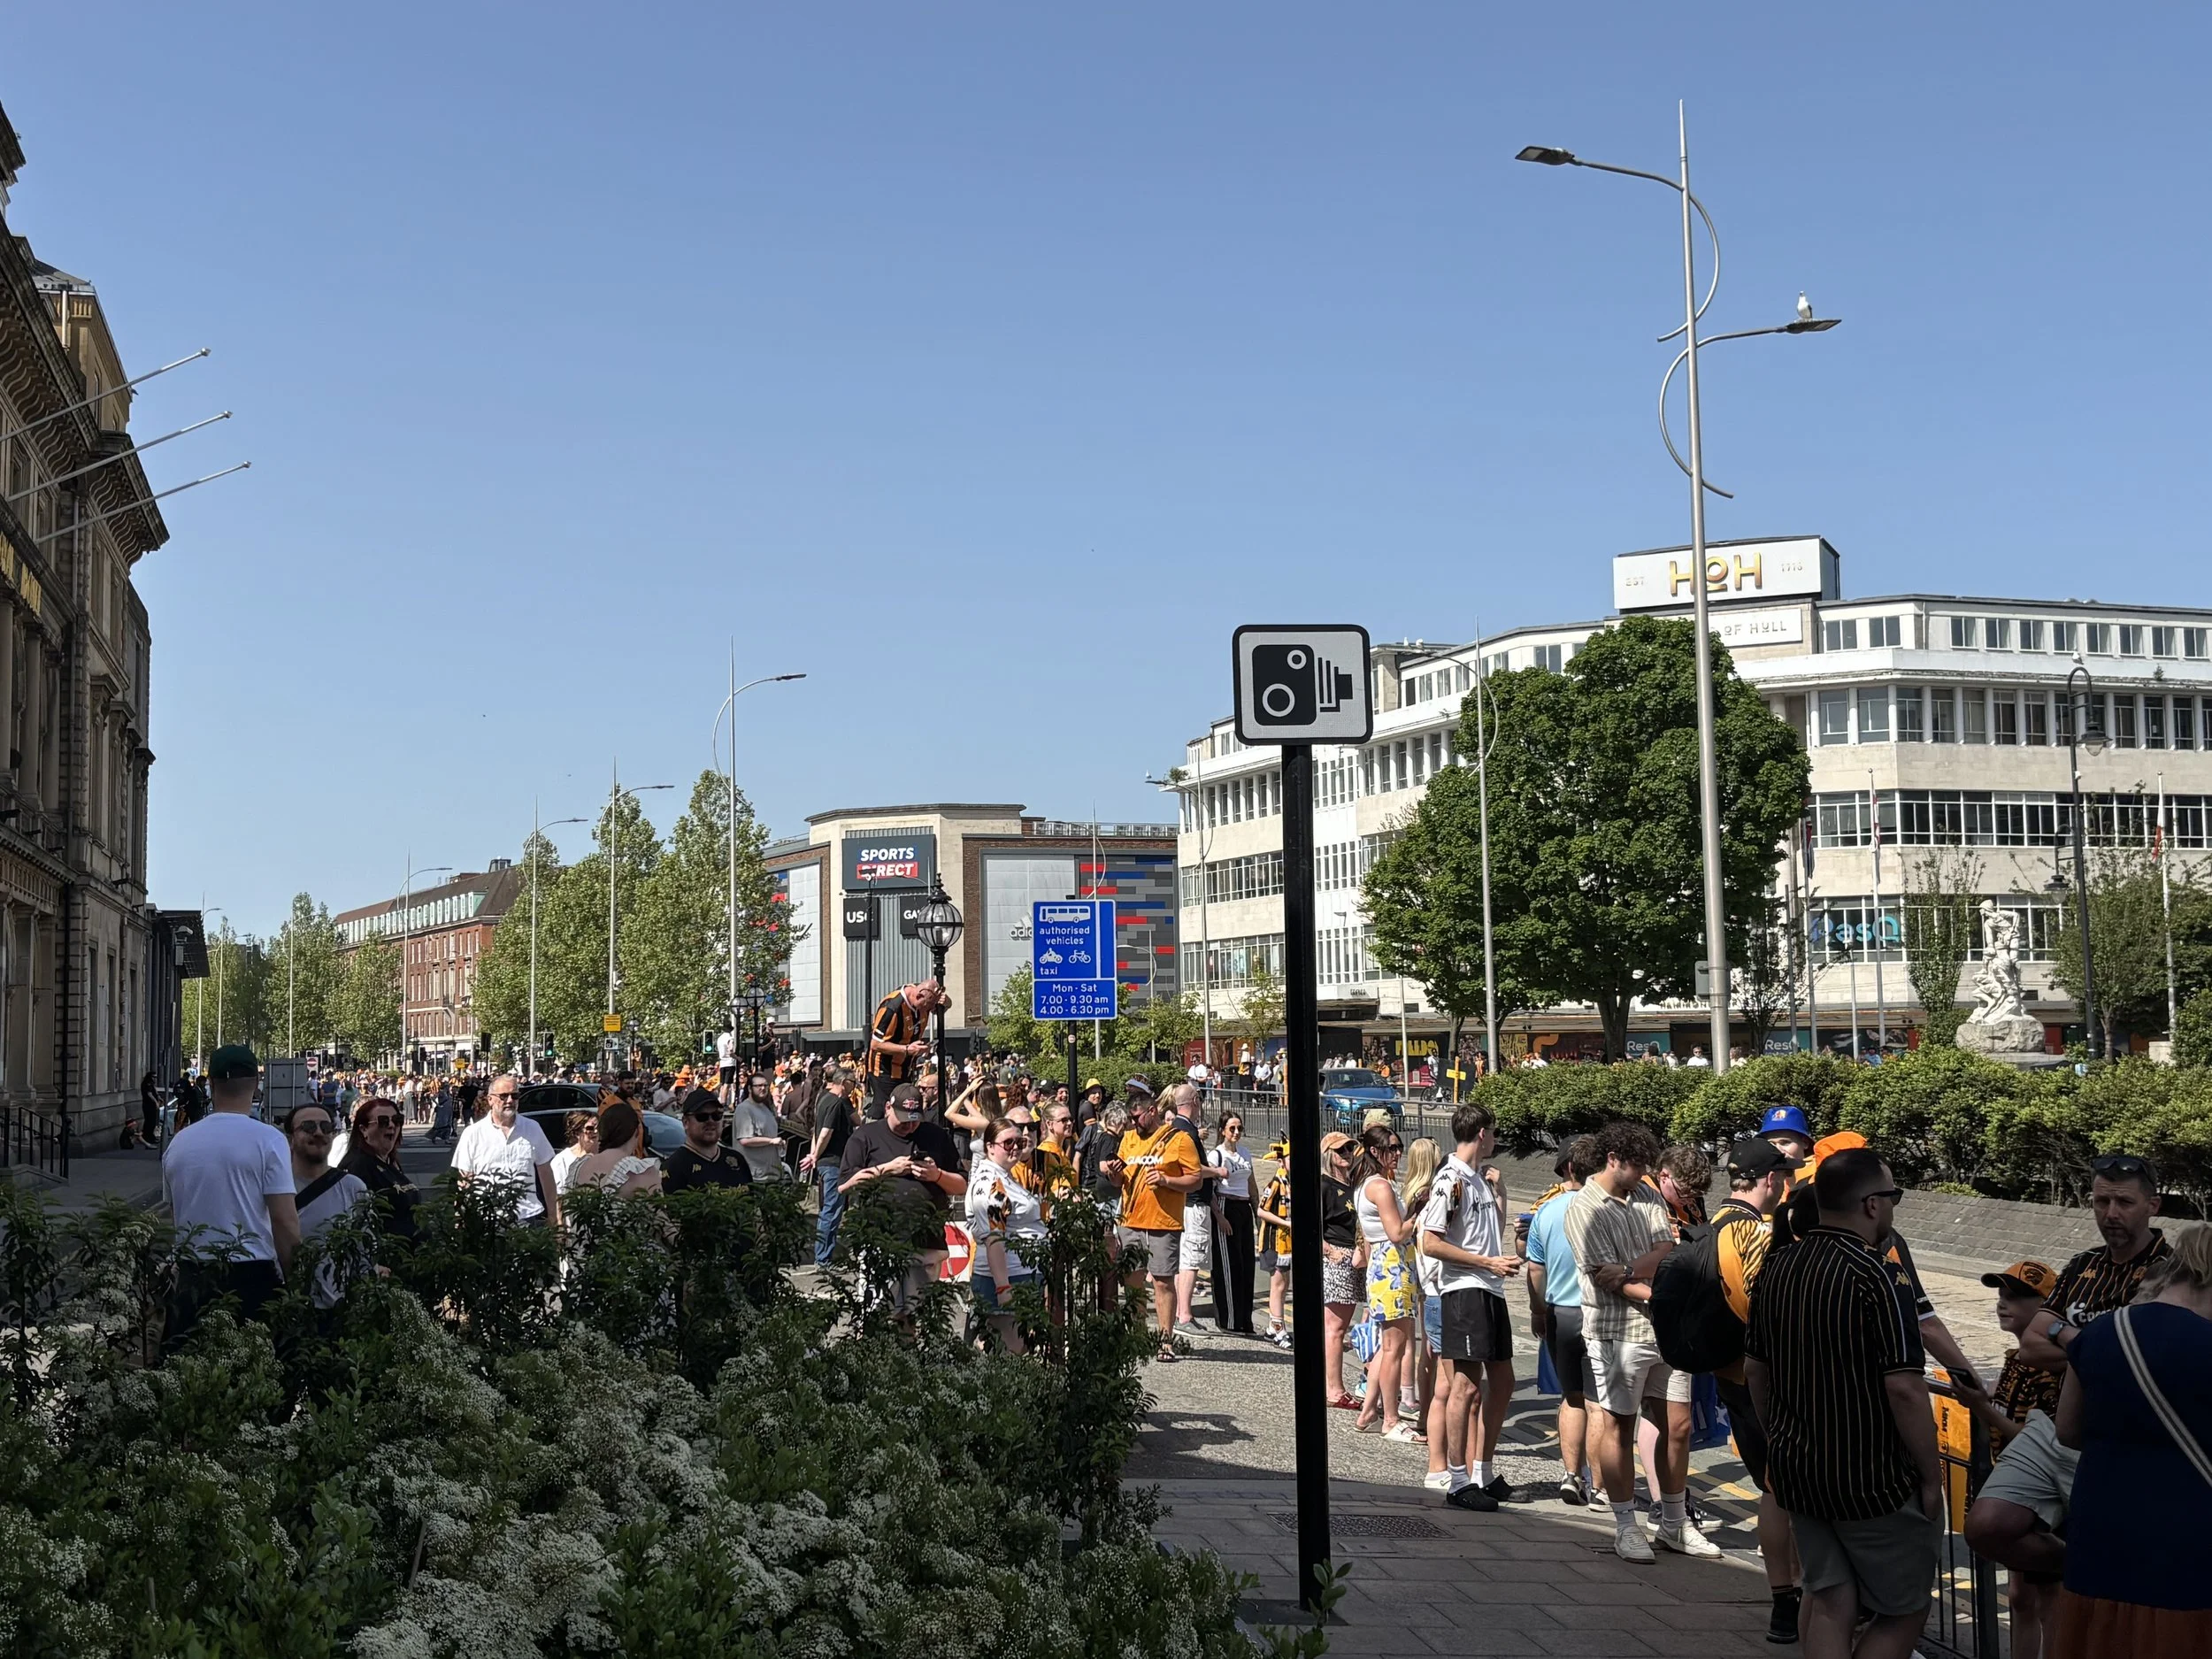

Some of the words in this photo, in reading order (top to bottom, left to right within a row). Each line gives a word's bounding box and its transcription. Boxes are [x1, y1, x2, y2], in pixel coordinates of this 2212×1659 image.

[1669, 551, 1762, 596] HOH
[1724, 624, 1742, 636] OF
[1749, 621, 1787, 634] HULL
[860, 847, 915, 862] SPORTS
[1039, 926, 1090, 935] authorised
[1046, 936, 1084, 945] vehicles
[1040, 966, 1058, 976] taxi
[1052, 984, 1073, 993] Mon
[1080, 983, 1098, 993] Sat
[1041, 995, 1063, 1004] 7.00
[1070, 995, 1093, 1004] 9.30
[1040, 1005, 1064, 1014] 4.00
[1071, 1005, 1093, 1014] 6.30
[1094, 1006, 1110, 1016] pm
